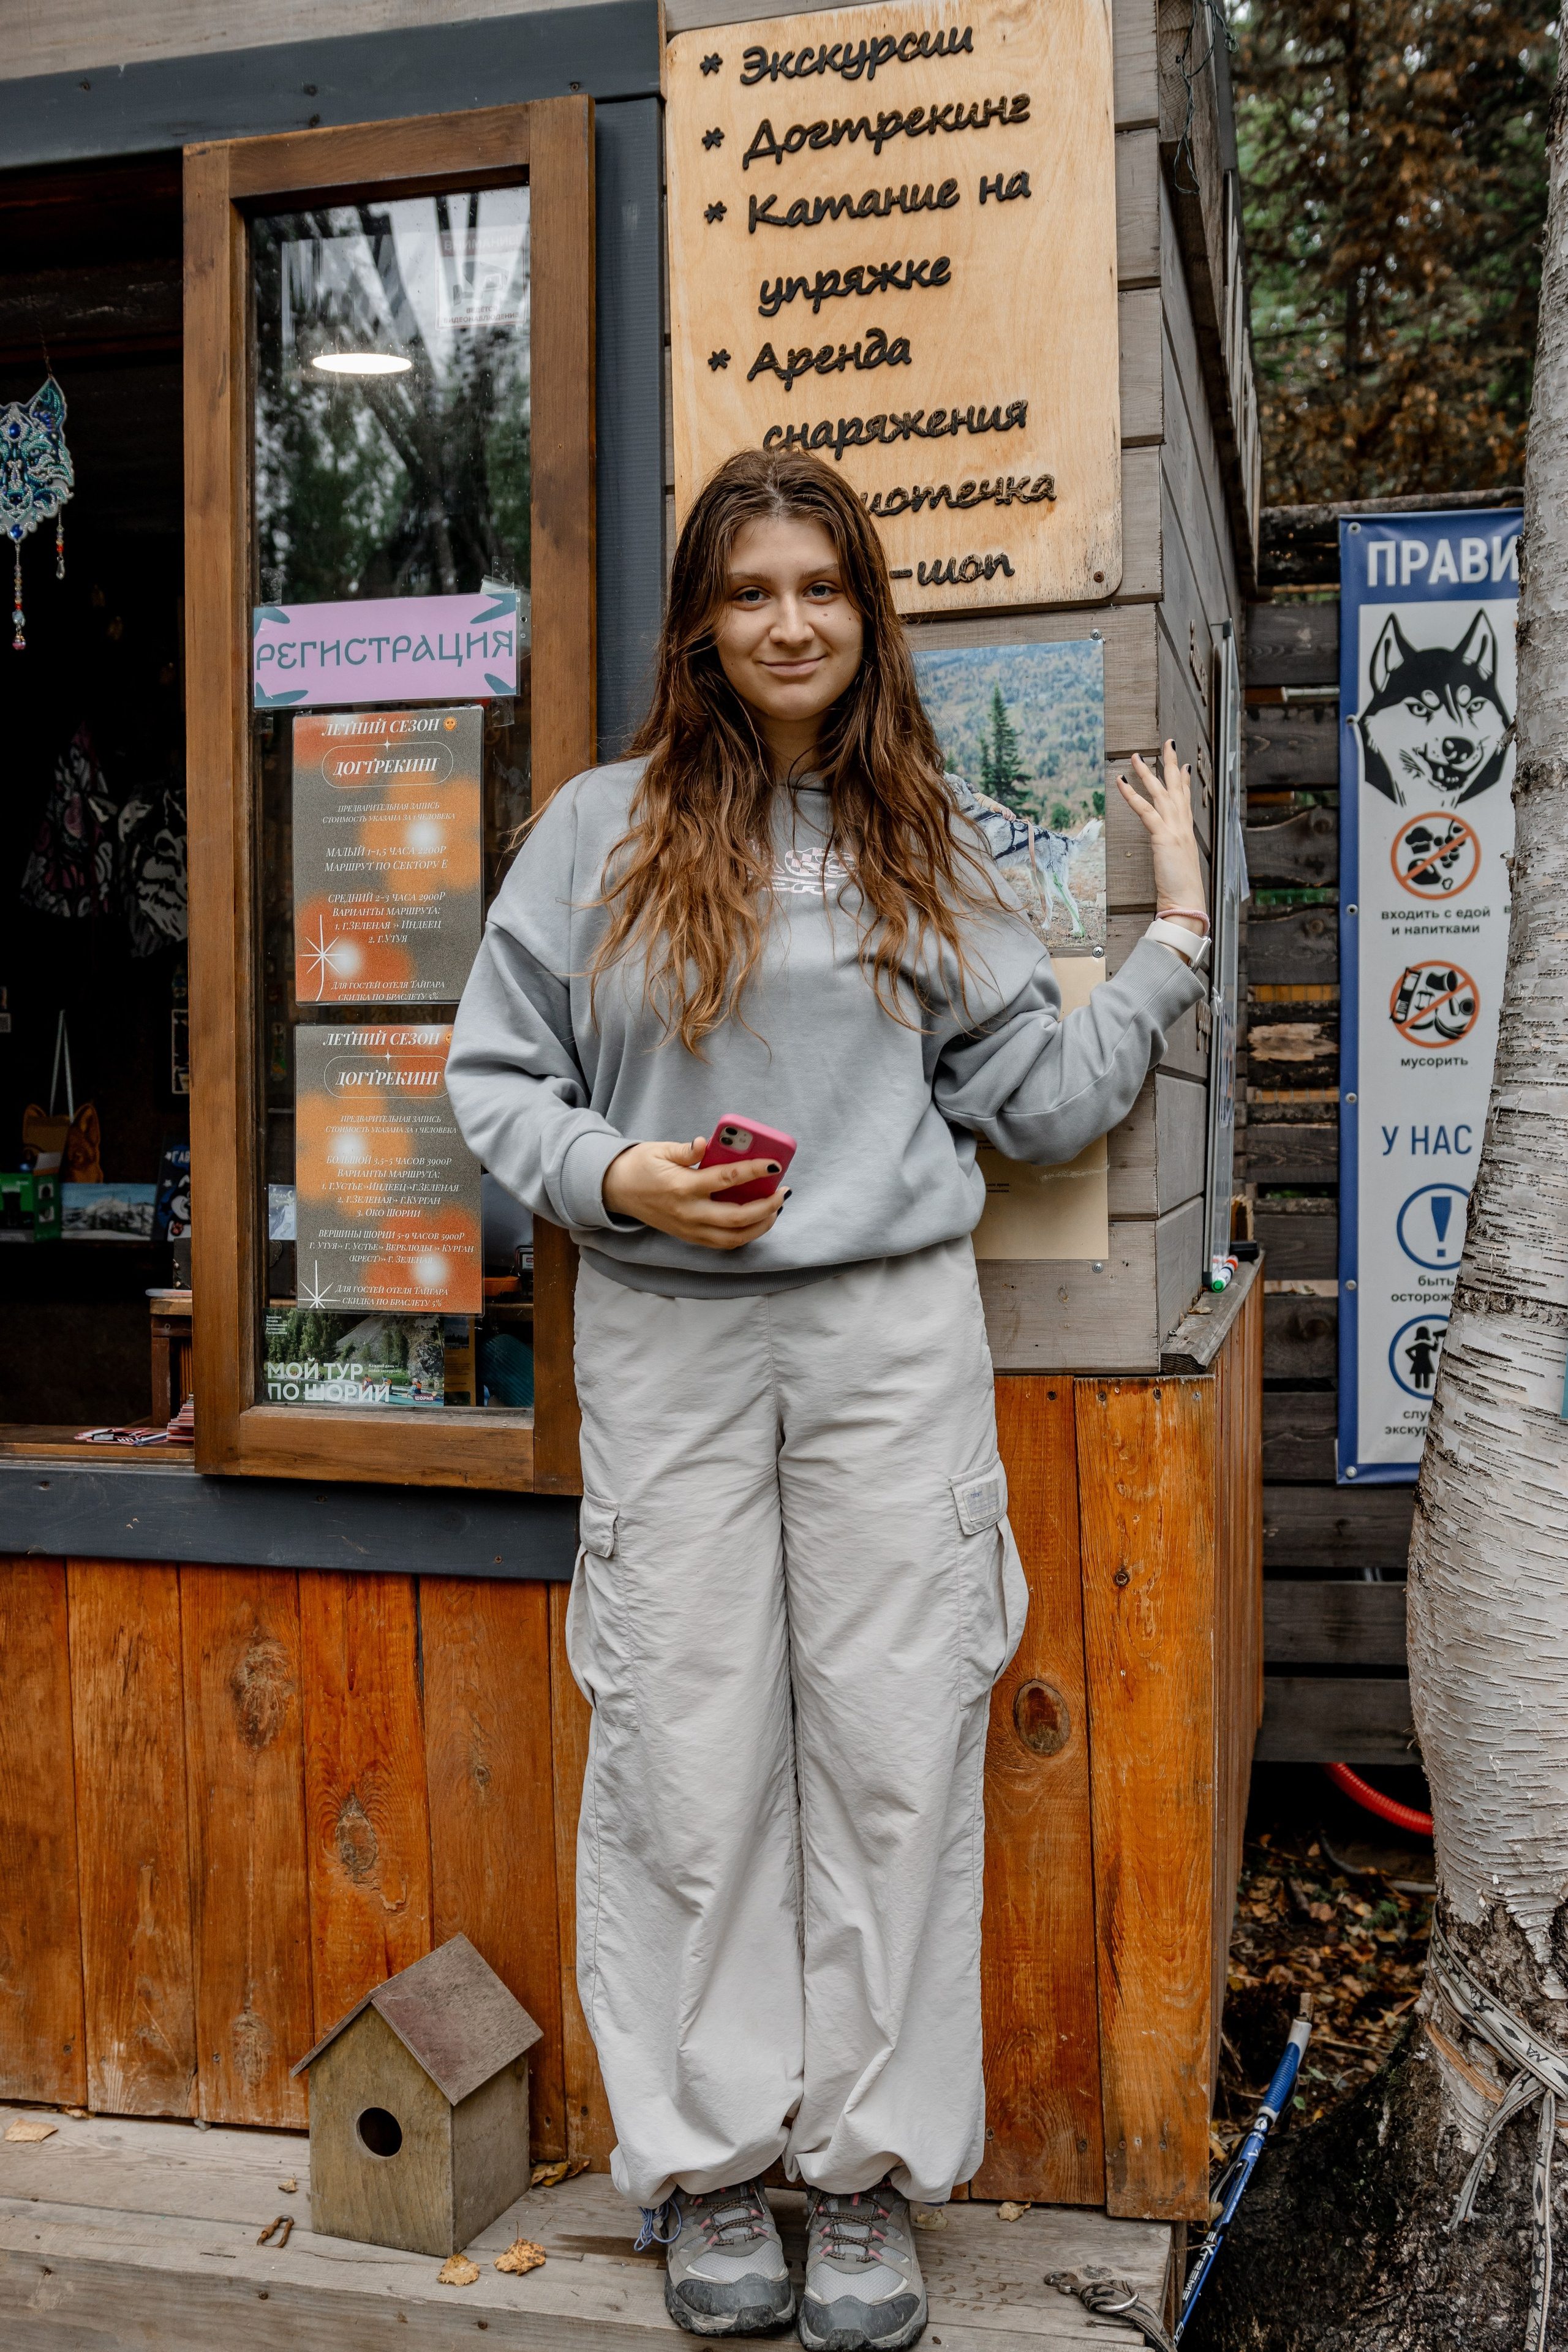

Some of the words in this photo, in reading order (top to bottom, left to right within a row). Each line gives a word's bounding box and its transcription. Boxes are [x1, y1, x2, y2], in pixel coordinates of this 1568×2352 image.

[741, 26, 973, 85] Экскурсии
[742, 93, 1031, 170] Догтрекинг
[748, 178, 960, 233] Катание
[979, 170, 1031, 204] на
[758, 256, 951, 316] упряжке
[747, 327, 911, 390] Аренда
[763, 399, 1028, 460] снаряжения
[859, 473, 1057, 516] иотечка
[889, 552, 1015, 586] -шоп
[1367, 535, 1519, 587] ПРАВИ
[256, 630, 513, 670] РЕГИСТРАЦИЯ
[322, 718, 386, 736] ЛЕТНИЙ
[390, 718, 440, 733] СЕЗОН
[333, 758, 440, 777] ДОГТРЕКИНГ
[337, 802, 409, 813] ПРЕДВАРИТЕЛЬНАЯ
[325, 845, 365, 857] МАЛЫЙ
[390, 846, 415, 855] ЧАСА
[375, 862, 390, 870] ПО
[328, 892, 374, 904] СРЕДНИЙ
[393, 893, 416, 902] ЧАСА
[418, 892, 445, 902] 2900Р
[1381, 910, 1440, 920] входить
[1457, 906, 1490, 919] едой
[1404, 925, 1480, 935] напитками
[349, 981, 380, 989] ГОСТЕЙ
[386, 992, 427, 1001] БРАСЛЕТУ
[322, 1030, 387, 1046] ЛЕТНИЙ
[390, 1032, 440, 1045] СЕЗОН
[1401, 1057, 1469, 1069] мусорить
[335, 1069, 441, 1087] ДОГТРЕКИНГ
[1382, 1126, 1399, 1156] У
[1412, 1124, 1472, 1155] НАС
[326, 1155, 372, 1164] БОЛЬШОЙ
[427, 1158, 452, 1166] 3900Р
[318, 1229, 362, 1238] ВЕРШИНЫ
[441, 1232, 465, 1241] 5900Р
[353, 1285, 385, 1294] ГОСТЕЙ
[1418, 1275, 1455, 1286] быть
[1391, 1293, 1452, 1304] осторож
[268, 1357, 318, 1379] МОЙ
[323, 1363, 363, 1381] ТУР
[268, 1383, 300, 1400] ПО
[305, 1384, 389, 1403] ШОРИИ
